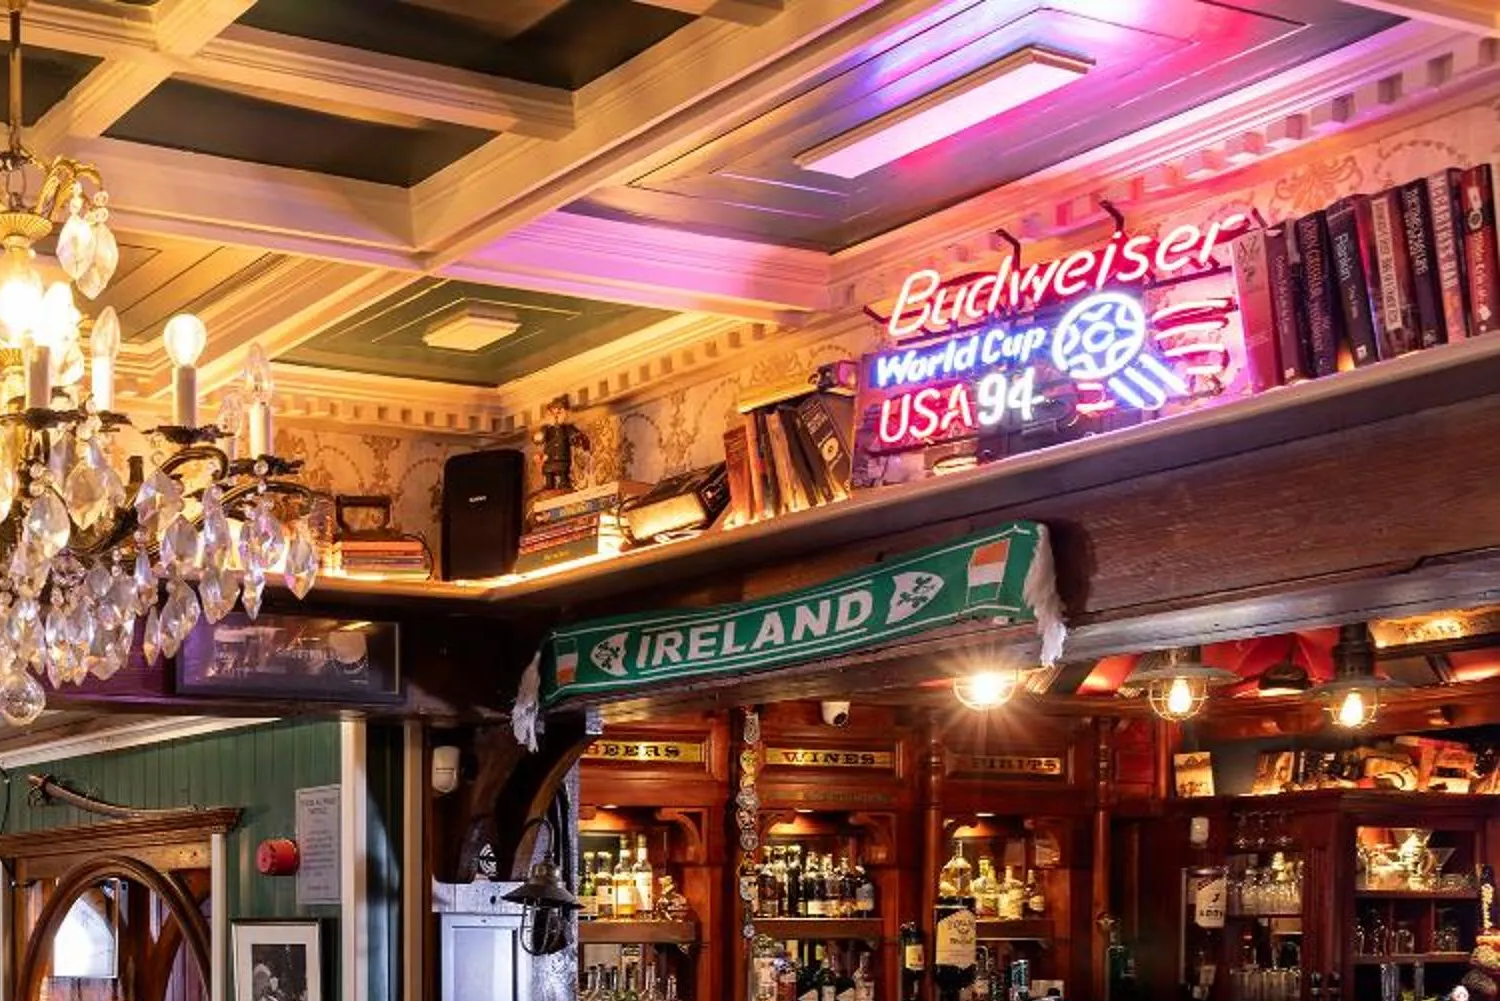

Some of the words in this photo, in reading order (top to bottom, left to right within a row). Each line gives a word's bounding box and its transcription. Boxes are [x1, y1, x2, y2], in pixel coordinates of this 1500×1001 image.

[888, 212, 1248, 334] Budweiser
[874, 331, 977, 388] World
[980, 324, 1046, 369] Cup
[878, 392, 974, 444] USA
[976, 366, 1042, 425] 94
[635, 590, 875, 669] IRELAND
[781, 751, 876, 765] WINES
